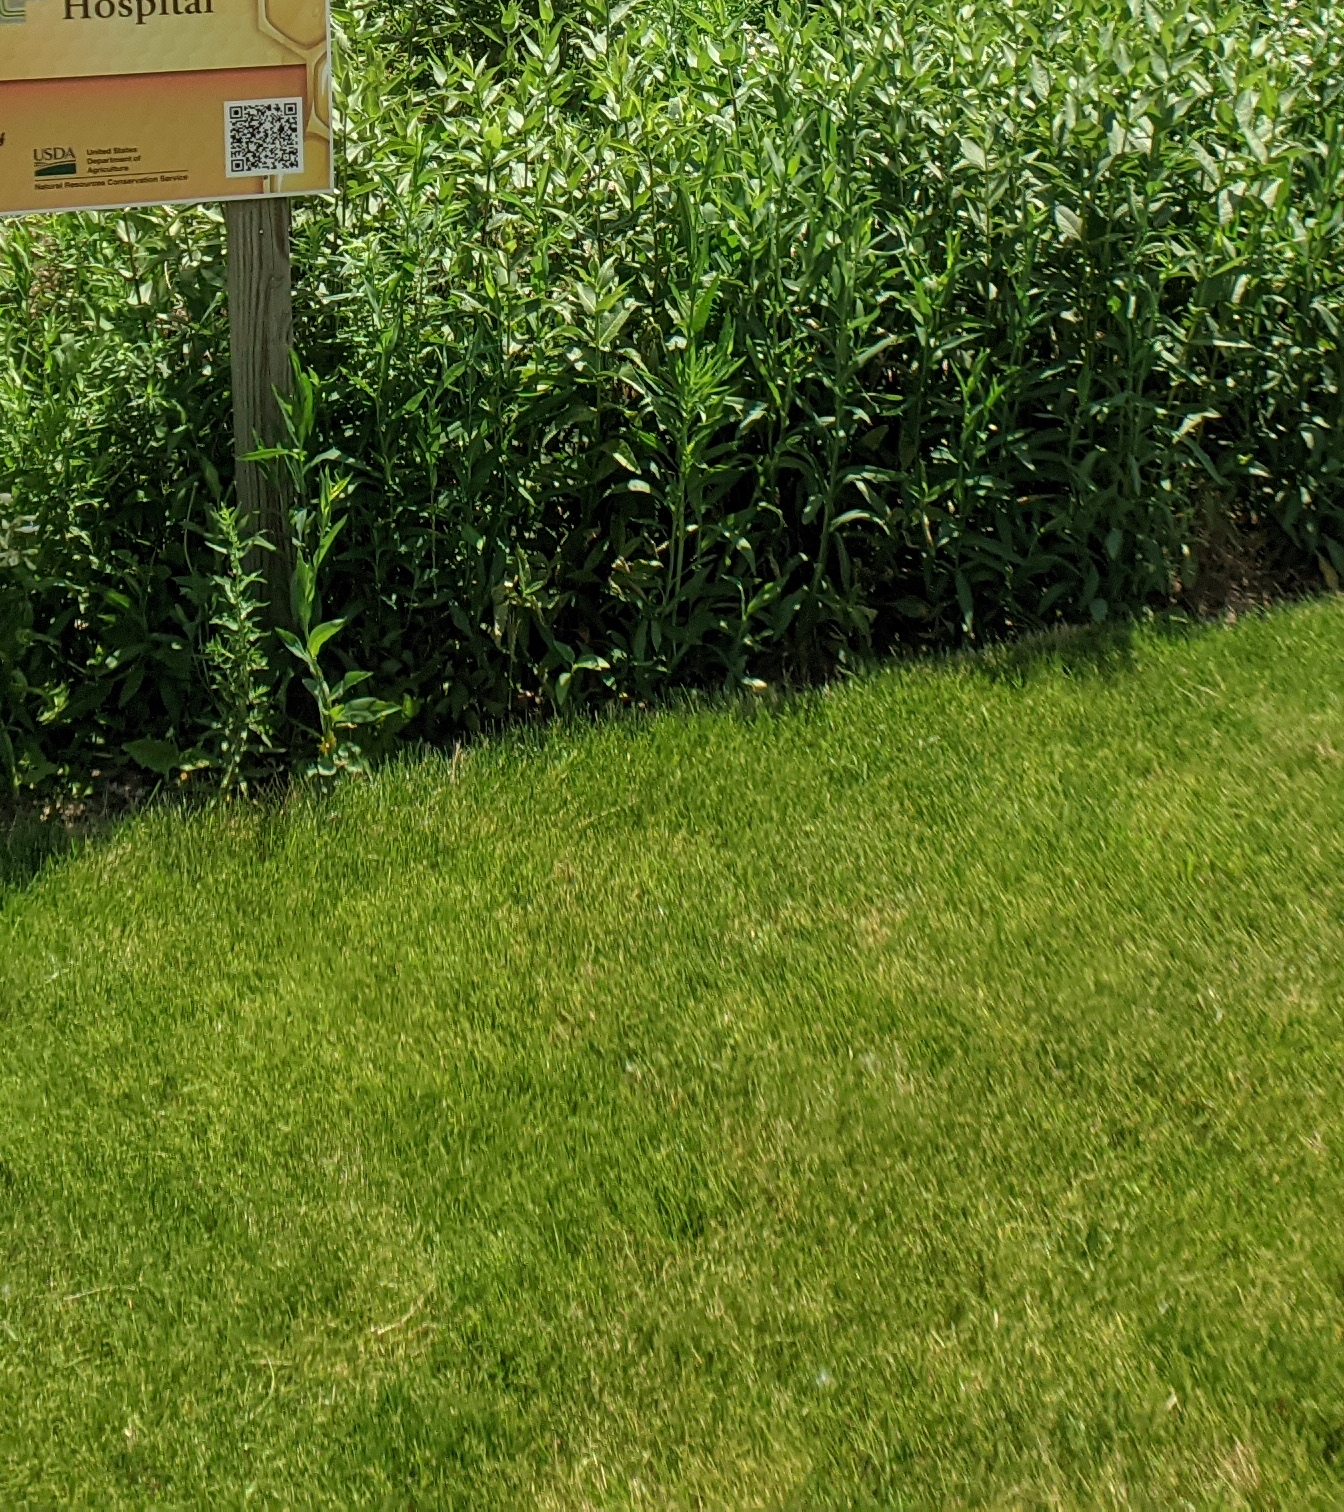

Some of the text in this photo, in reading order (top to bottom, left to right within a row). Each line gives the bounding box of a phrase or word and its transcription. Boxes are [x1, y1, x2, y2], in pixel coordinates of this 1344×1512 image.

[33, 146, 77, 162] USDA
[86, 146, 139, 156] United States
[86, 155, 132, 166] Department
[86, 165, 130, 175] Agriculture
